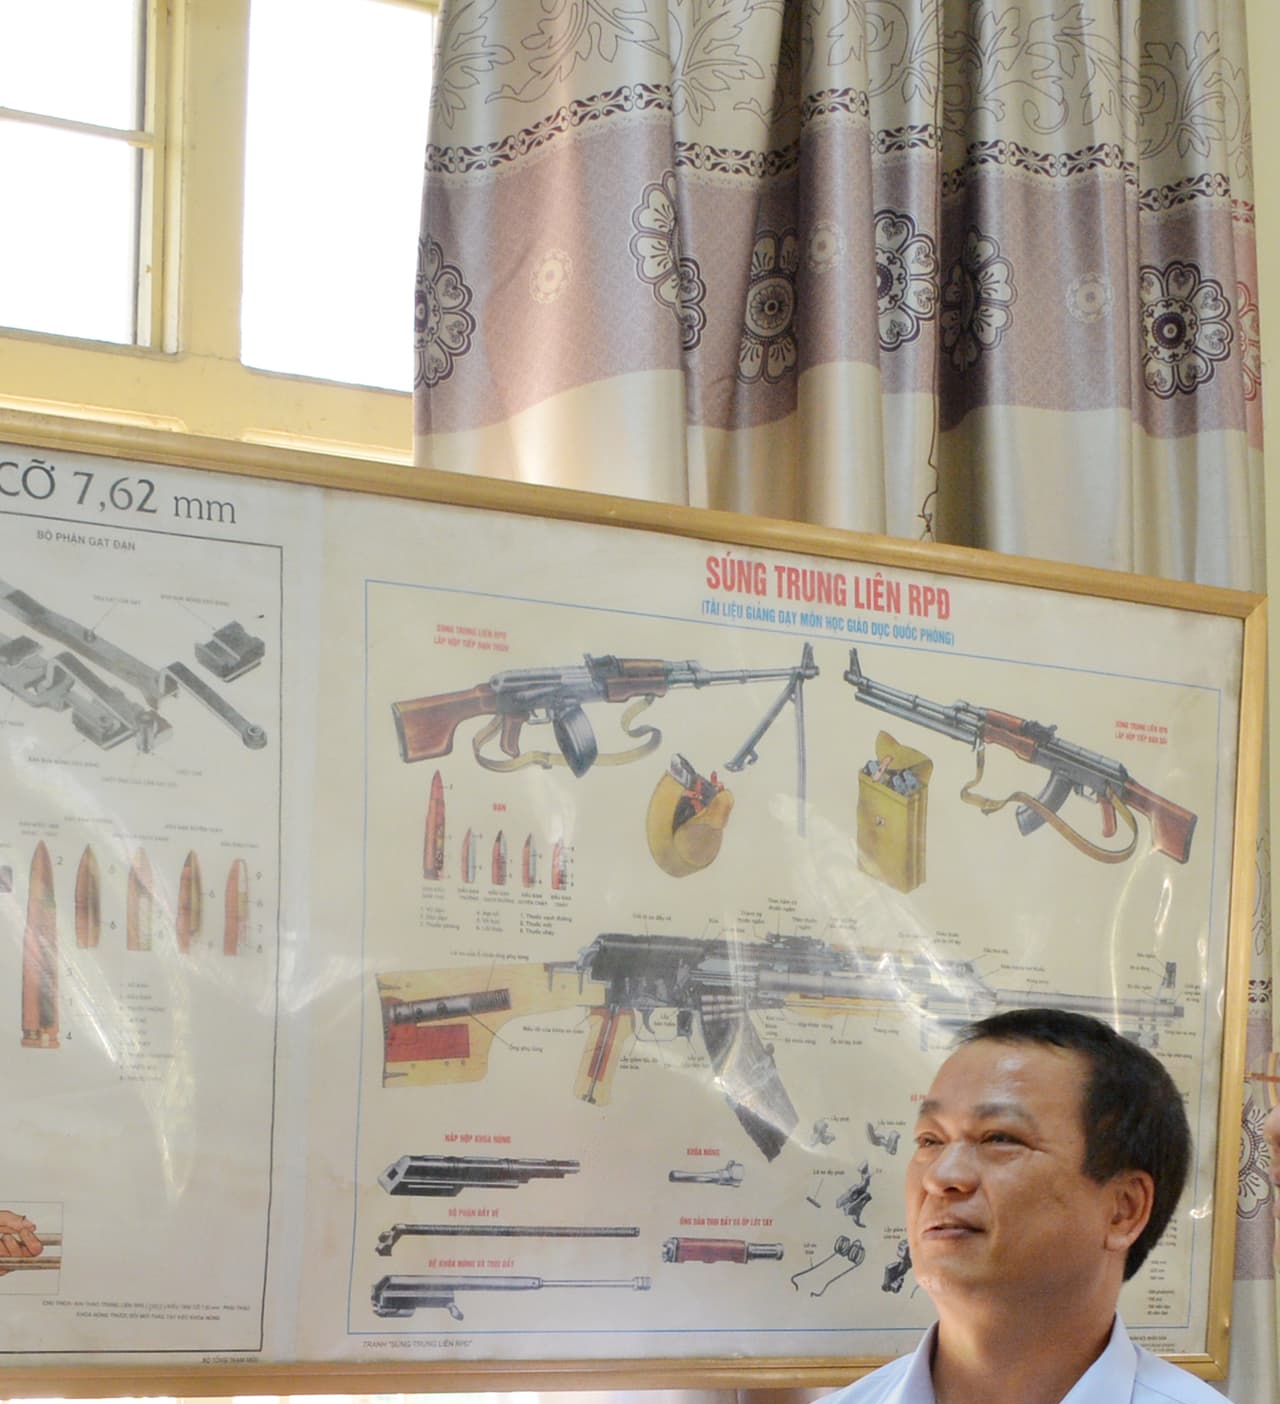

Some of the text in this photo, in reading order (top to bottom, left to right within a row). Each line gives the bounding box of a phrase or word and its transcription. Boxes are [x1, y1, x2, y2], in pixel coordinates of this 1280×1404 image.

[72, 471, 158, 514] 7,62
[173, 494, 237, 524] mm
[706, 552, 951, 621] SÚNG TRUNG LIÊN RPĐ
[800, 609, 823, 628] MÔN
[826, 615, 845, 634] HỌC
[847, 615, 869, 635] GIÁO
[871, 621, 890, 640] DỤC
[892, 620, 918, 641] QUỐC
